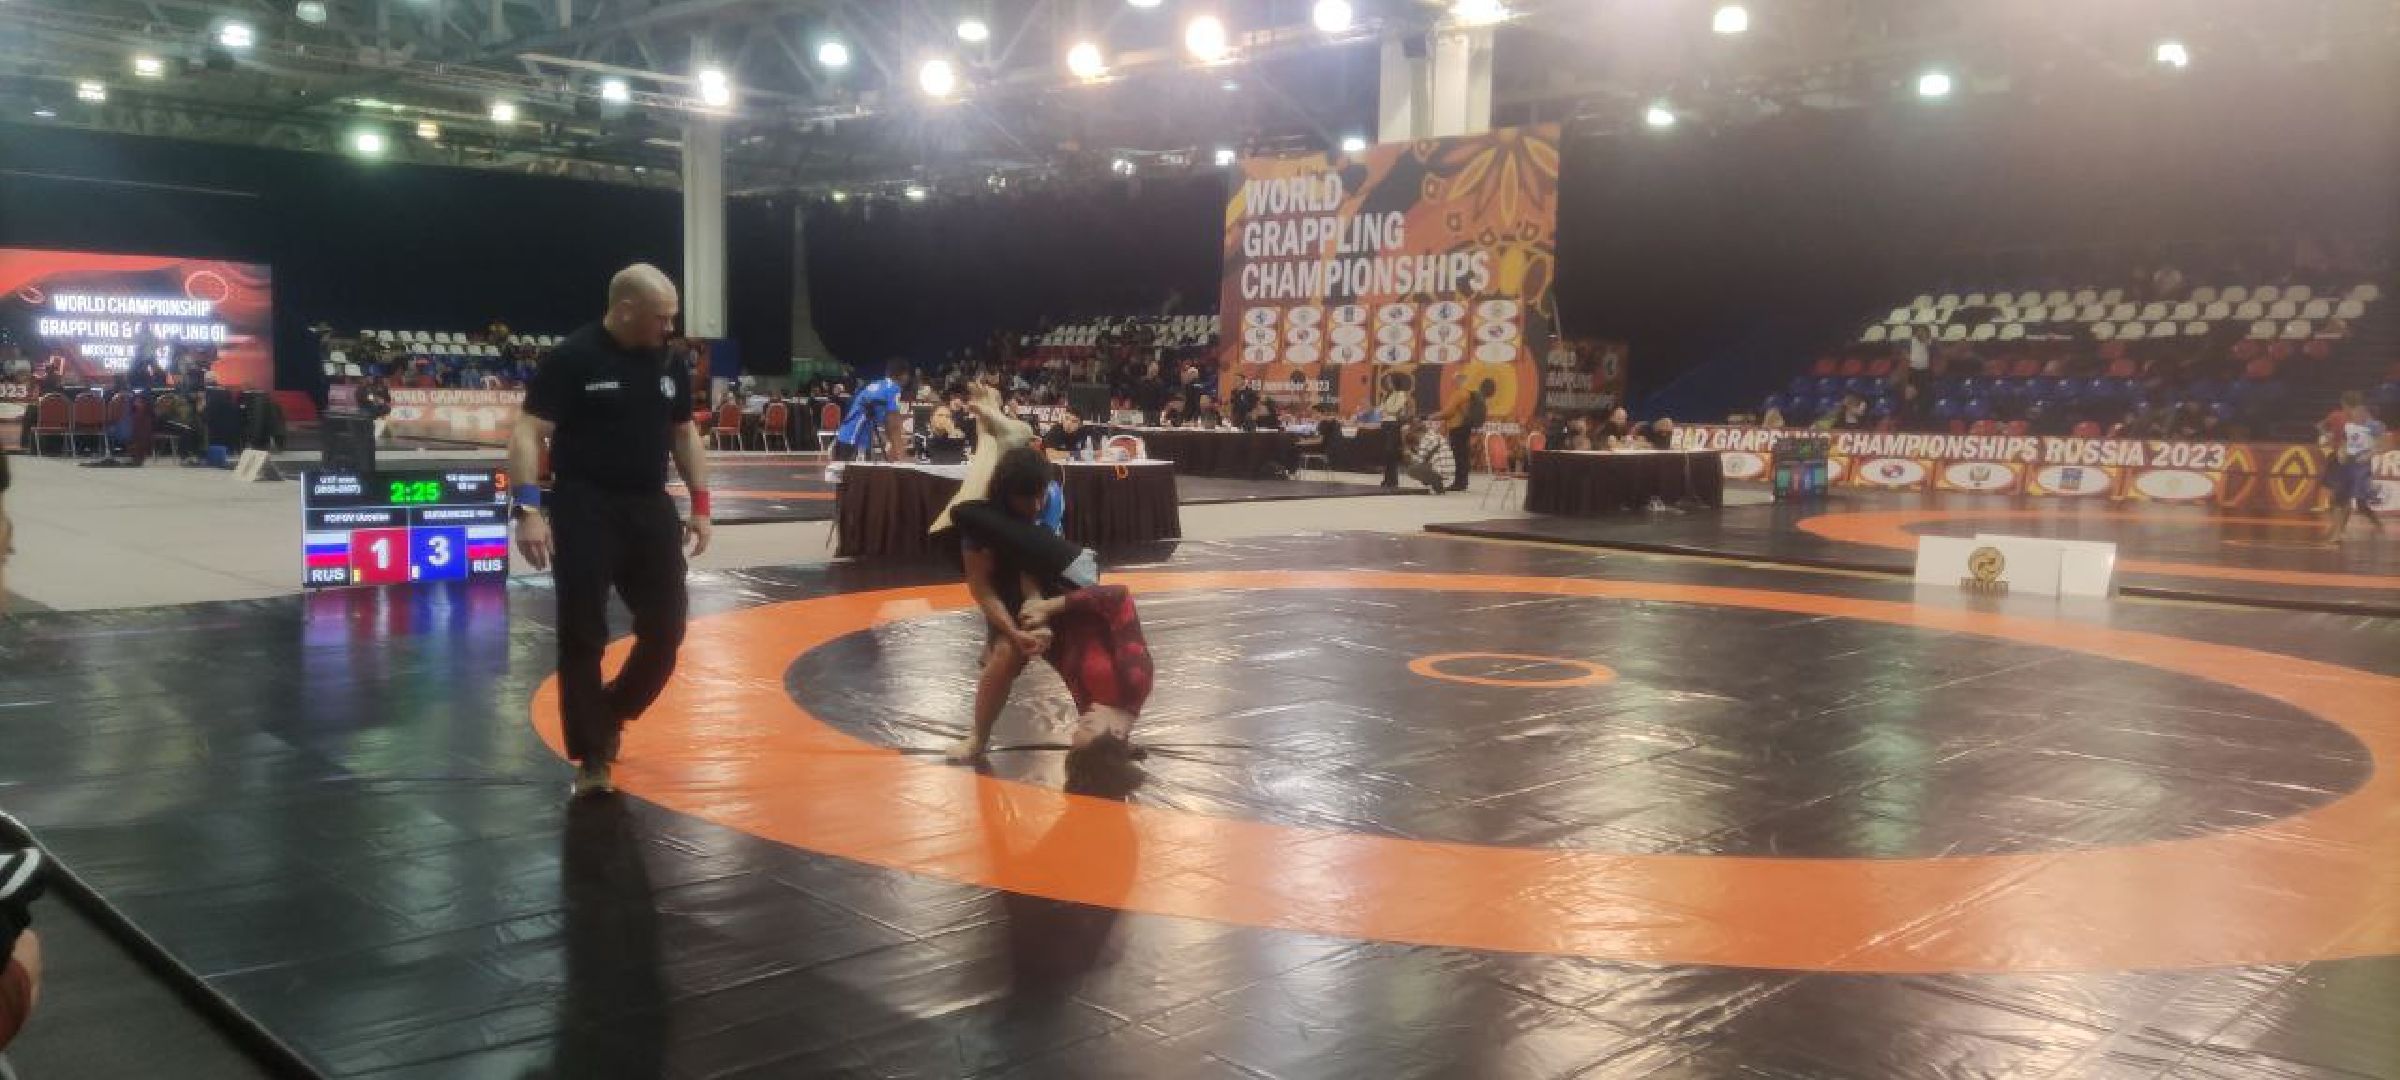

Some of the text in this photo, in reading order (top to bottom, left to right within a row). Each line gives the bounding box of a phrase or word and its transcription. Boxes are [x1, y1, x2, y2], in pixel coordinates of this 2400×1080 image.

[1246, 173, 1343, 215] WORLD
[1243, 211, 1405, 258] GRAPPLING
[1241, 250, 1489, 300] CHAMPIONSHIPS
[54, 295, 211, 316] WORLD CHAMPIONSHIP
[40, 318, 119, 337] GRAPPLING
[1838, 433, 2039, 461] CHAMPIONSHIPS
[2045, 436, 2144, 465] RUSSIA
[2151, 442, 2226, 467] 2023
[390, 481, 438, 503] 2:25
[371, 537, 391, 570] 1
[428, 535, 451, 567] 3
[473, 559, 502, 572] RUS
[312, 568, 345, 582] RUS
